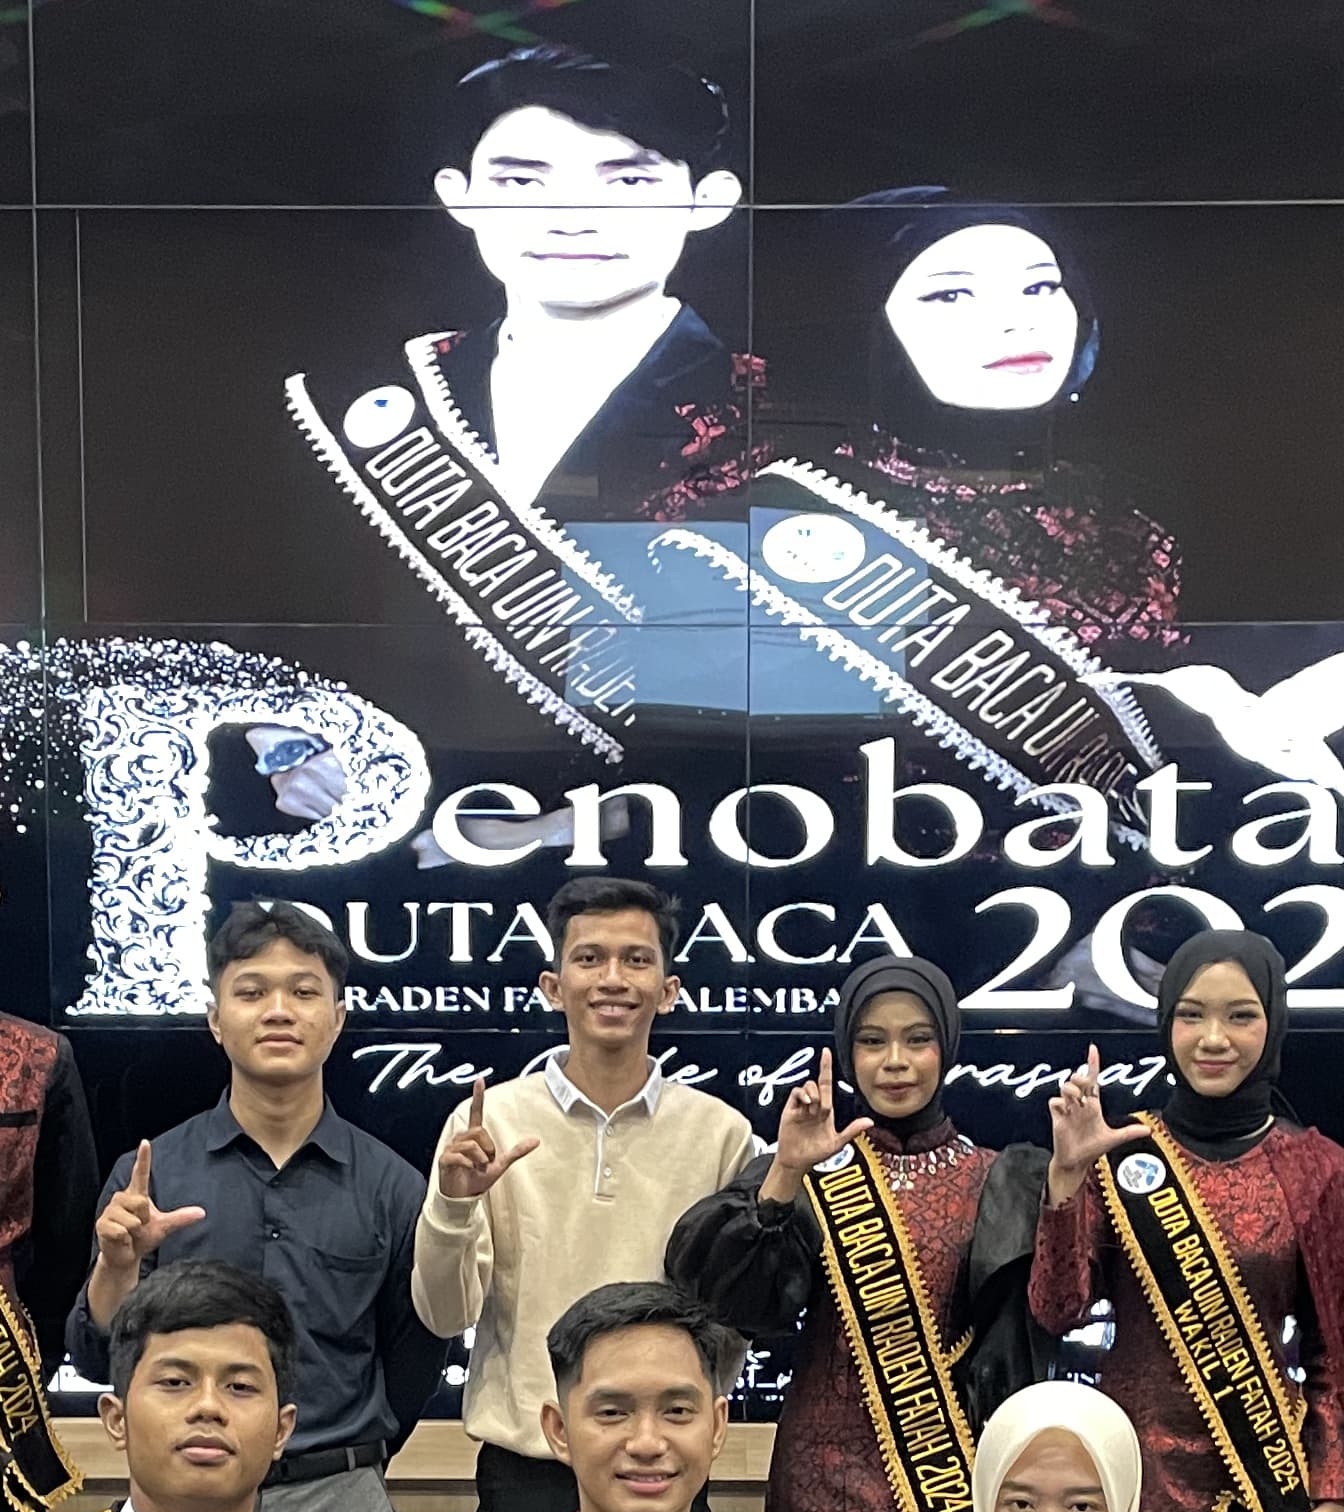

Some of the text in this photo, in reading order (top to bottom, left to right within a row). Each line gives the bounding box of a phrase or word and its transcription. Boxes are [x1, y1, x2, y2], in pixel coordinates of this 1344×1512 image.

[364, 425, 474, 532] DUTA
[426, 500, 538, 598] BACA
[491, 569, 594, 668] UIN
[821, 551, 972, 669] DUTA
[929, 629, 1068, 741] BACA
[258, 901, 554, 964] UTA
[674, 901, 916, 964] ACA
[343, 985, 491, 1012] RADEN
[818, 1163, 862, 1231] DUTA
[838, 1216, 896, 1288] BACA
[859, 1271, 899, 1322] UIN
[871, 1311, 922, 1398] RADEN
[1147, 1186, 1301, 1496] DUTA BACA UIN RADEN FATAH 2024
[1173, 1300, 1235, 1401] WAKIL 1
[894, 1382, 954, 1466] FATAH
